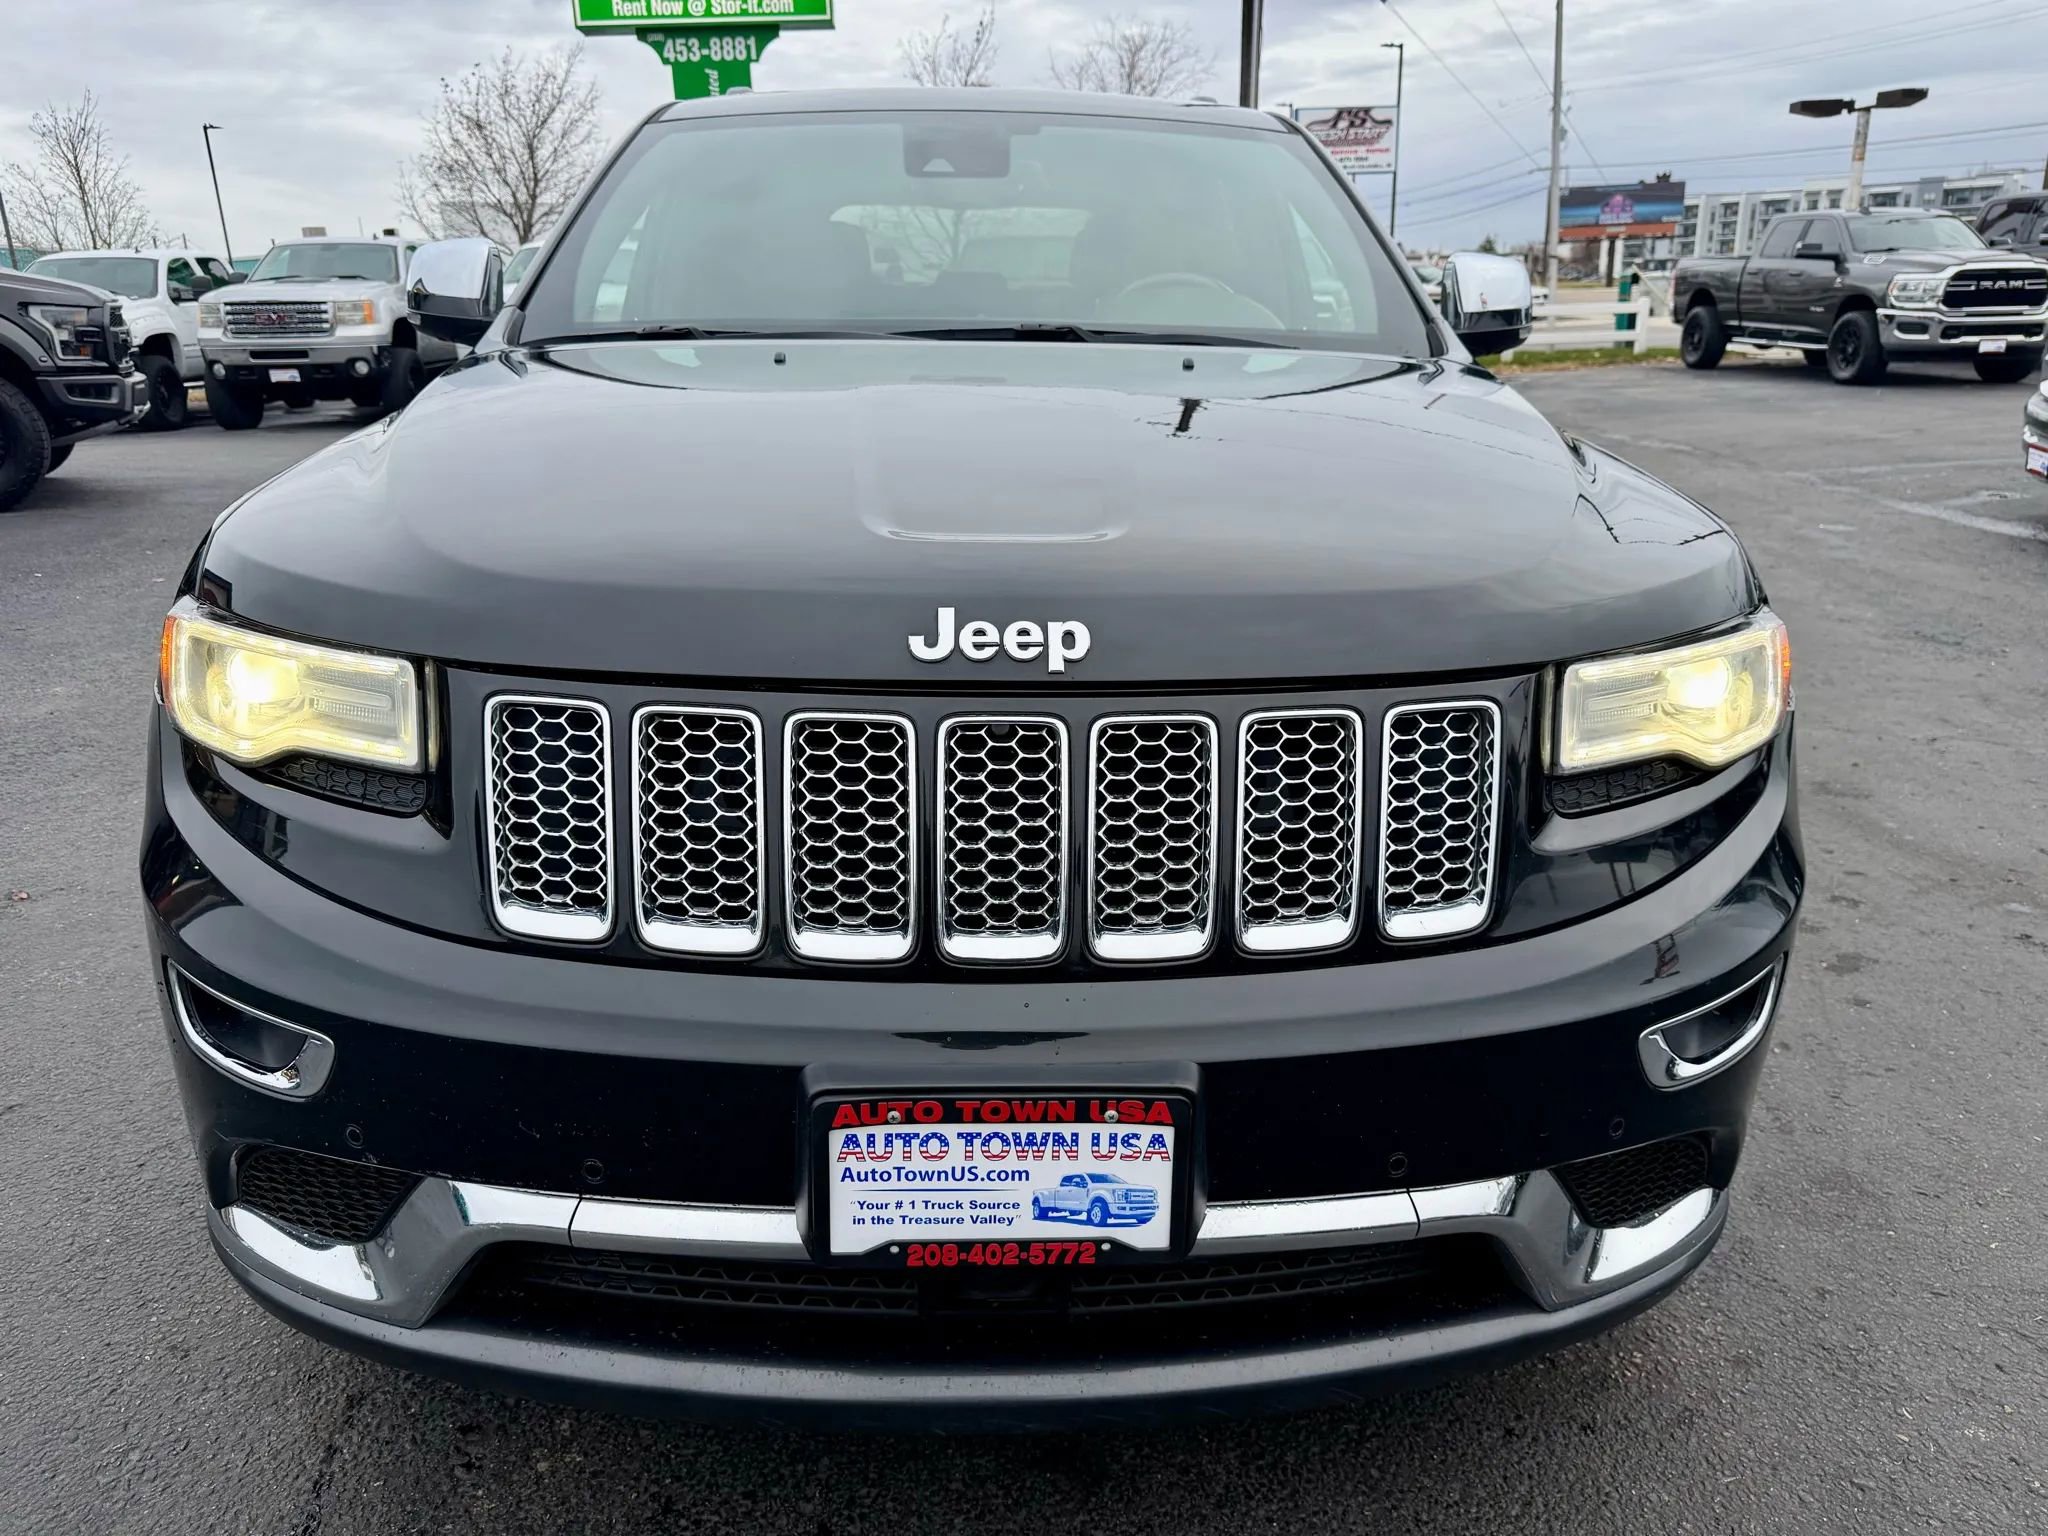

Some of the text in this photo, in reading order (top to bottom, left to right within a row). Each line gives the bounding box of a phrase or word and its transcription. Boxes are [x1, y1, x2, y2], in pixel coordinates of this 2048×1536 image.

[612, 0, 648, 16] Rent
[651, 0, 684, 16] Now
[687, 0, 706, 16] @
[663, 36, 757, 62] 453-8881
[1979, 280, 2024, 290] RAM
[908, 607, 1091, 674] Jeep
[832, 1100, 1174, 1127] AUTO TOWN USA
[837, 1131, 1171, 1162] AUTO TOWN USA
[840, 1166, 1030, 1183] AutoTownUS.com
[908, 1200, 916, 1209] 1
[922, 1200, 964, 1210] Truck
[969, 1200, 1021, 1210] Source
[852, 1216, 866, 1225] in
[870, 1215, 895, 1225] the
[900, 1214, 965, 1225] Treasure
[906, 1242, 1096, 1267] 208-402-5772
